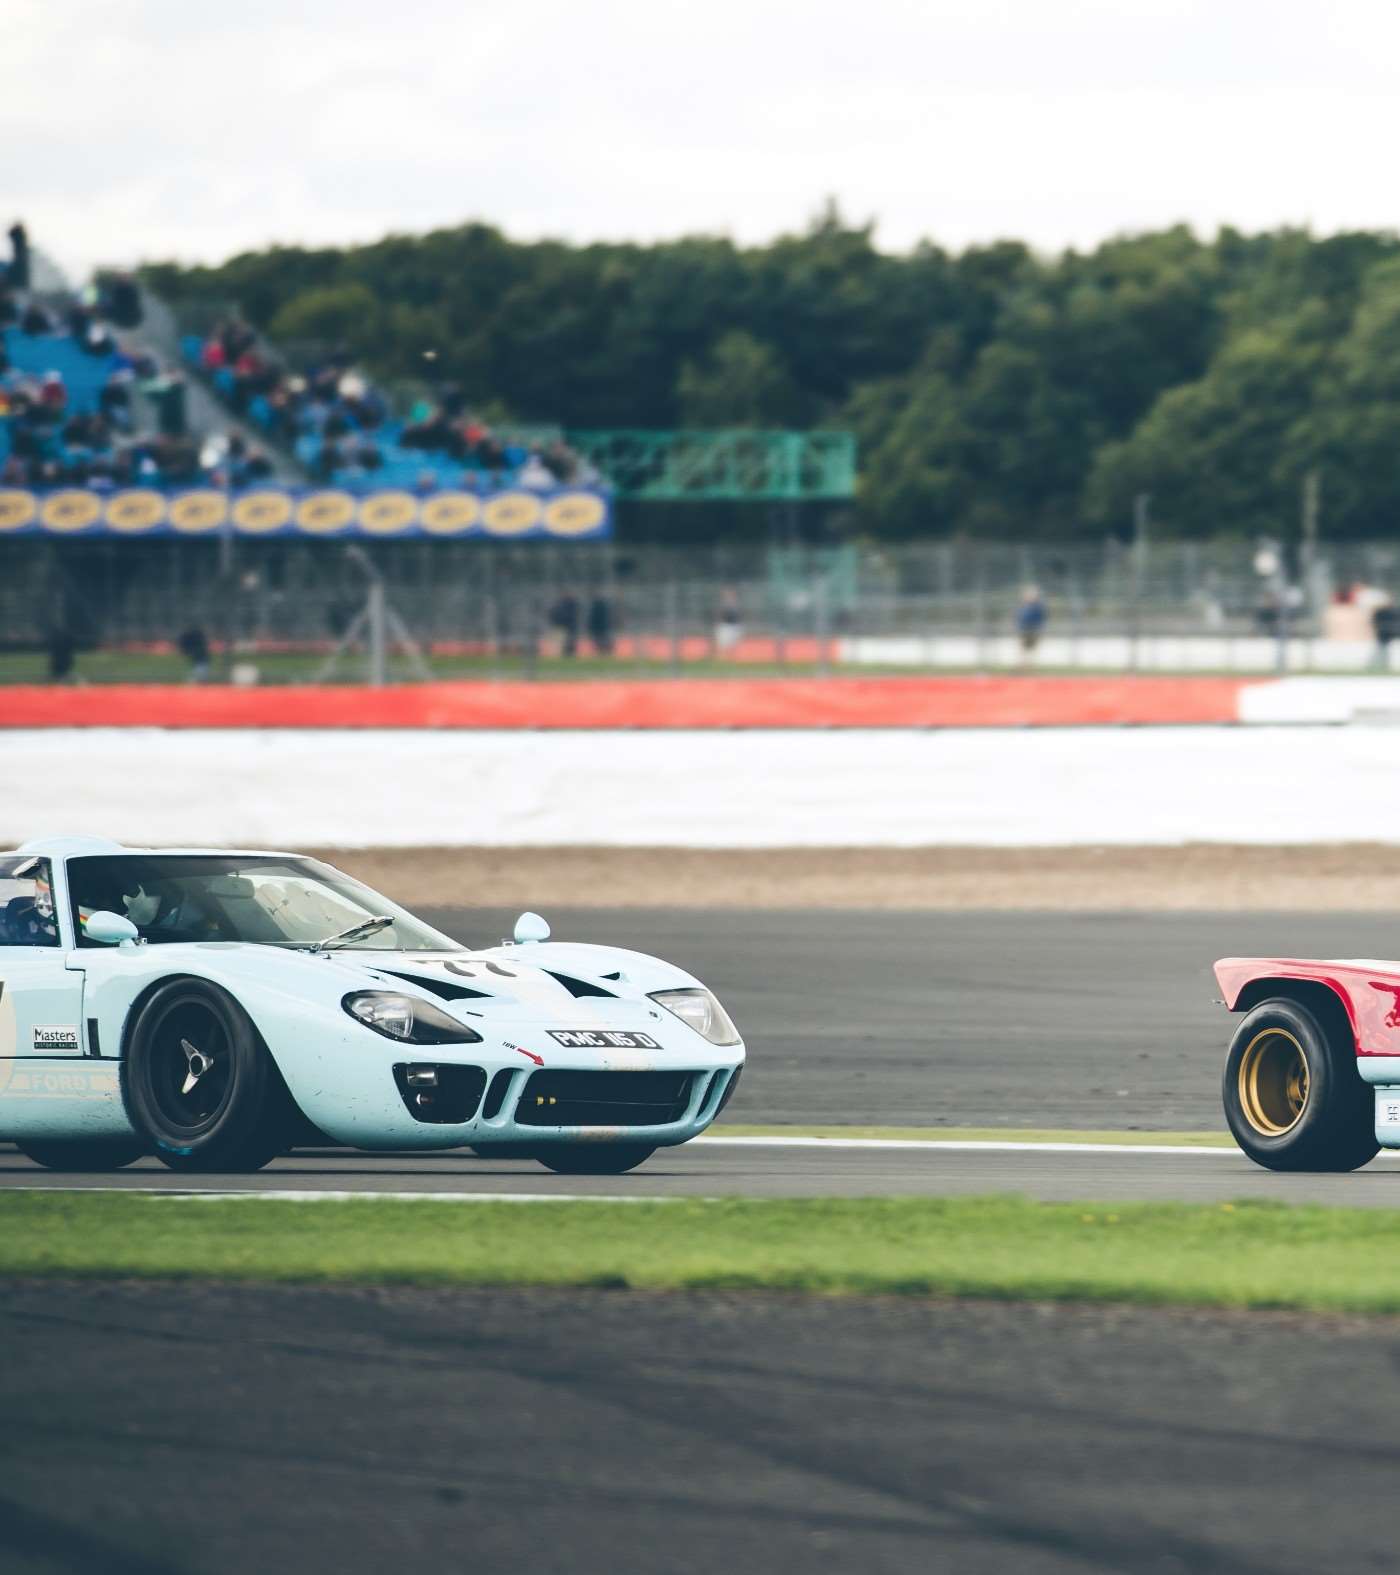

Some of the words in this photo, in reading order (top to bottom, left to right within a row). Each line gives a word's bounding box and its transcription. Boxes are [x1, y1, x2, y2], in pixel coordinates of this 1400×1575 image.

[34, 1028, 76, 1041] Masters
[552, 1031, 605, 1046] PMC
[602, 1032, 636, 1047] 115
[633, 1033, 657, 1048] D
[32, 1073, 89, 1091] FORD
